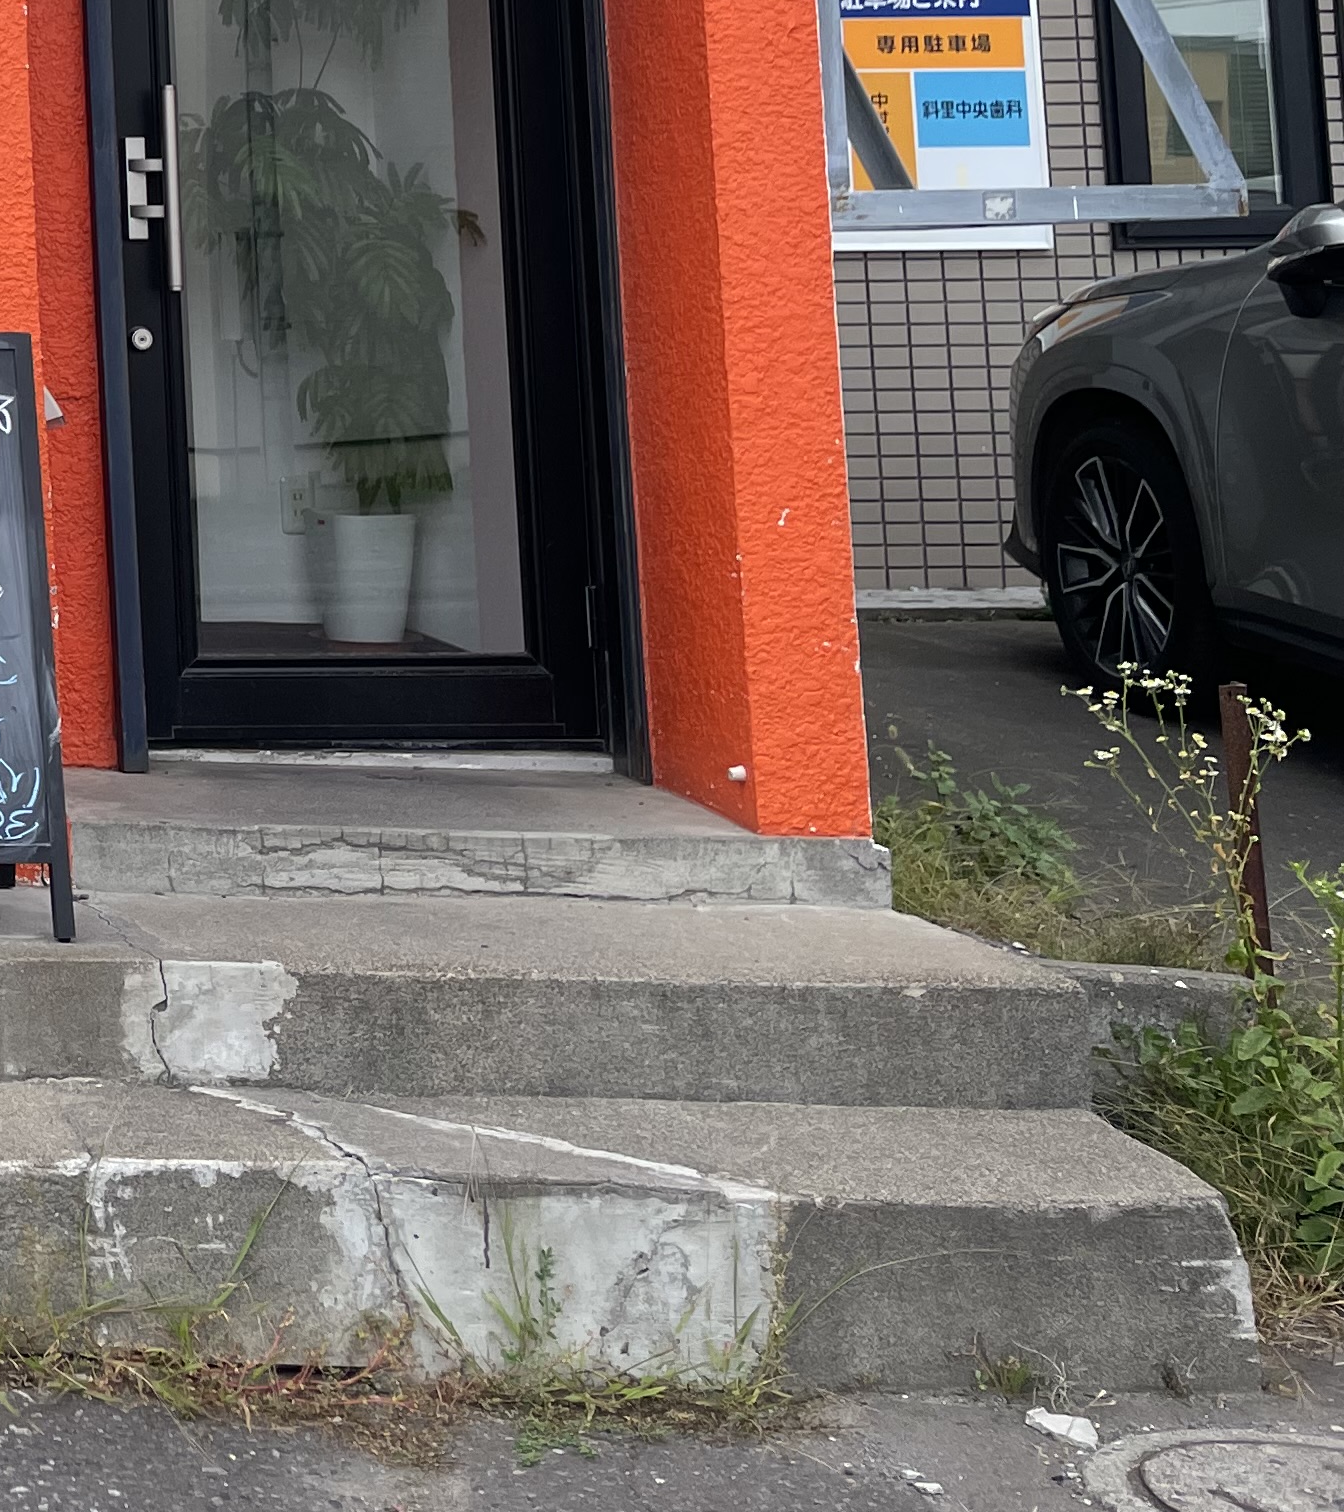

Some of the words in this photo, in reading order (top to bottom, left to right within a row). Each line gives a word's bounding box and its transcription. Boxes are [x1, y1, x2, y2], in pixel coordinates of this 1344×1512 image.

[876, 34, 991, 54] 専用駐車場
[922, 99, 1023, 119] 斜里中央歯科
